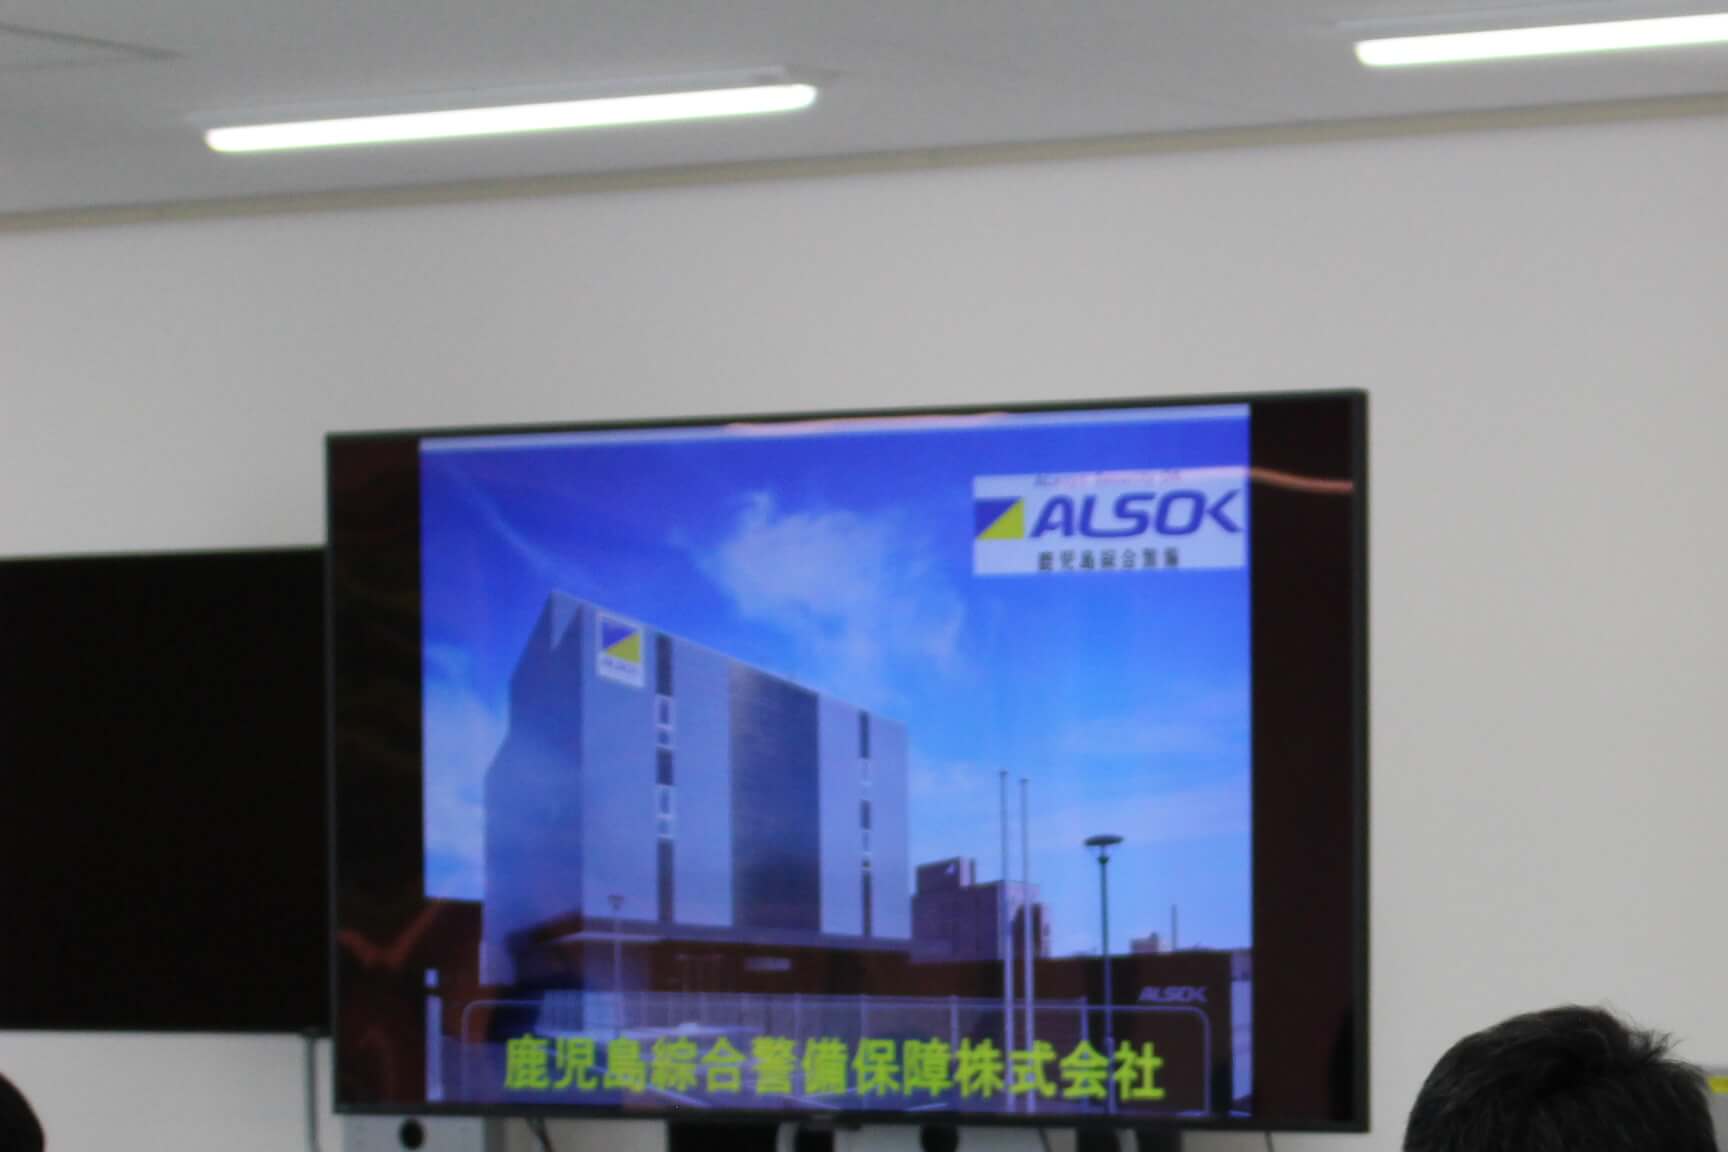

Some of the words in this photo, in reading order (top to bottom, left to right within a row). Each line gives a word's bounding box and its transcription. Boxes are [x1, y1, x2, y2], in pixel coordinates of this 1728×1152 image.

[1029, 488, 1242, 539] ALSOK
[503, 1035, 1165, 1102] 鹿児島綜合警備保障株式会社
